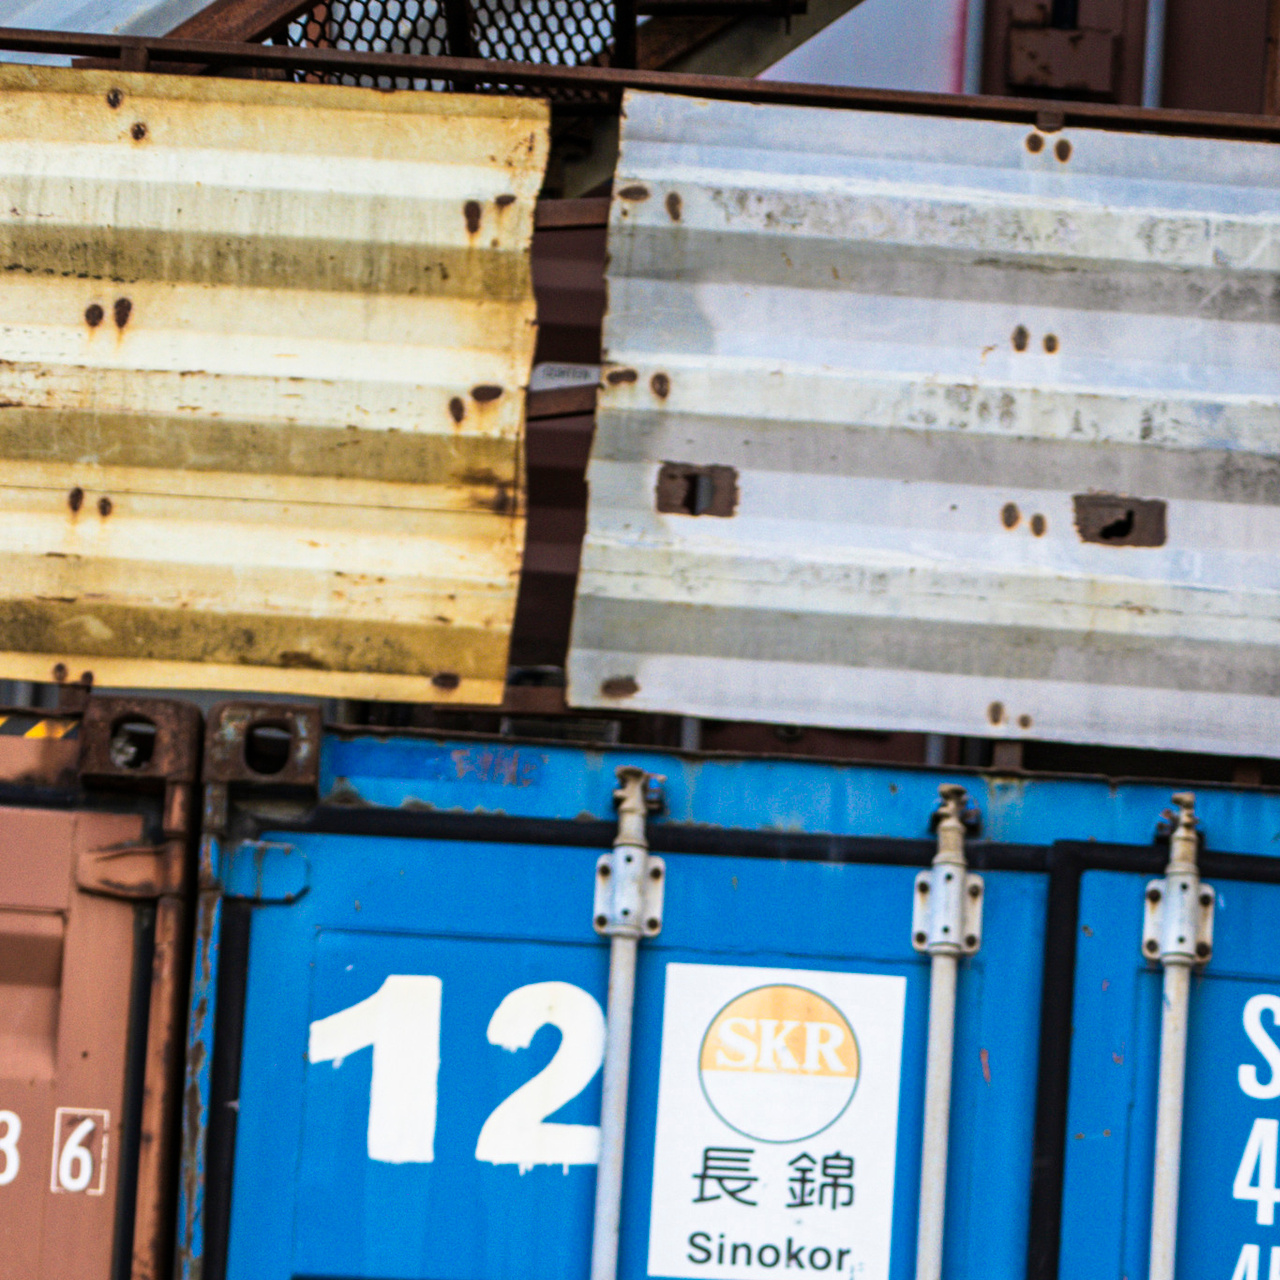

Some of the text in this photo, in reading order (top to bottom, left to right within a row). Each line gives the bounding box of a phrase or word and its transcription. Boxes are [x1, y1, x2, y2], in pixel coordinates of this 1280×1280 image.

[308, 974, 606, 1174] 12
[712, 1015, 850, 1073] SKR
[59, 1118, 95, 1191] 6
[686, 1231, 852, 1274] Sinokor
